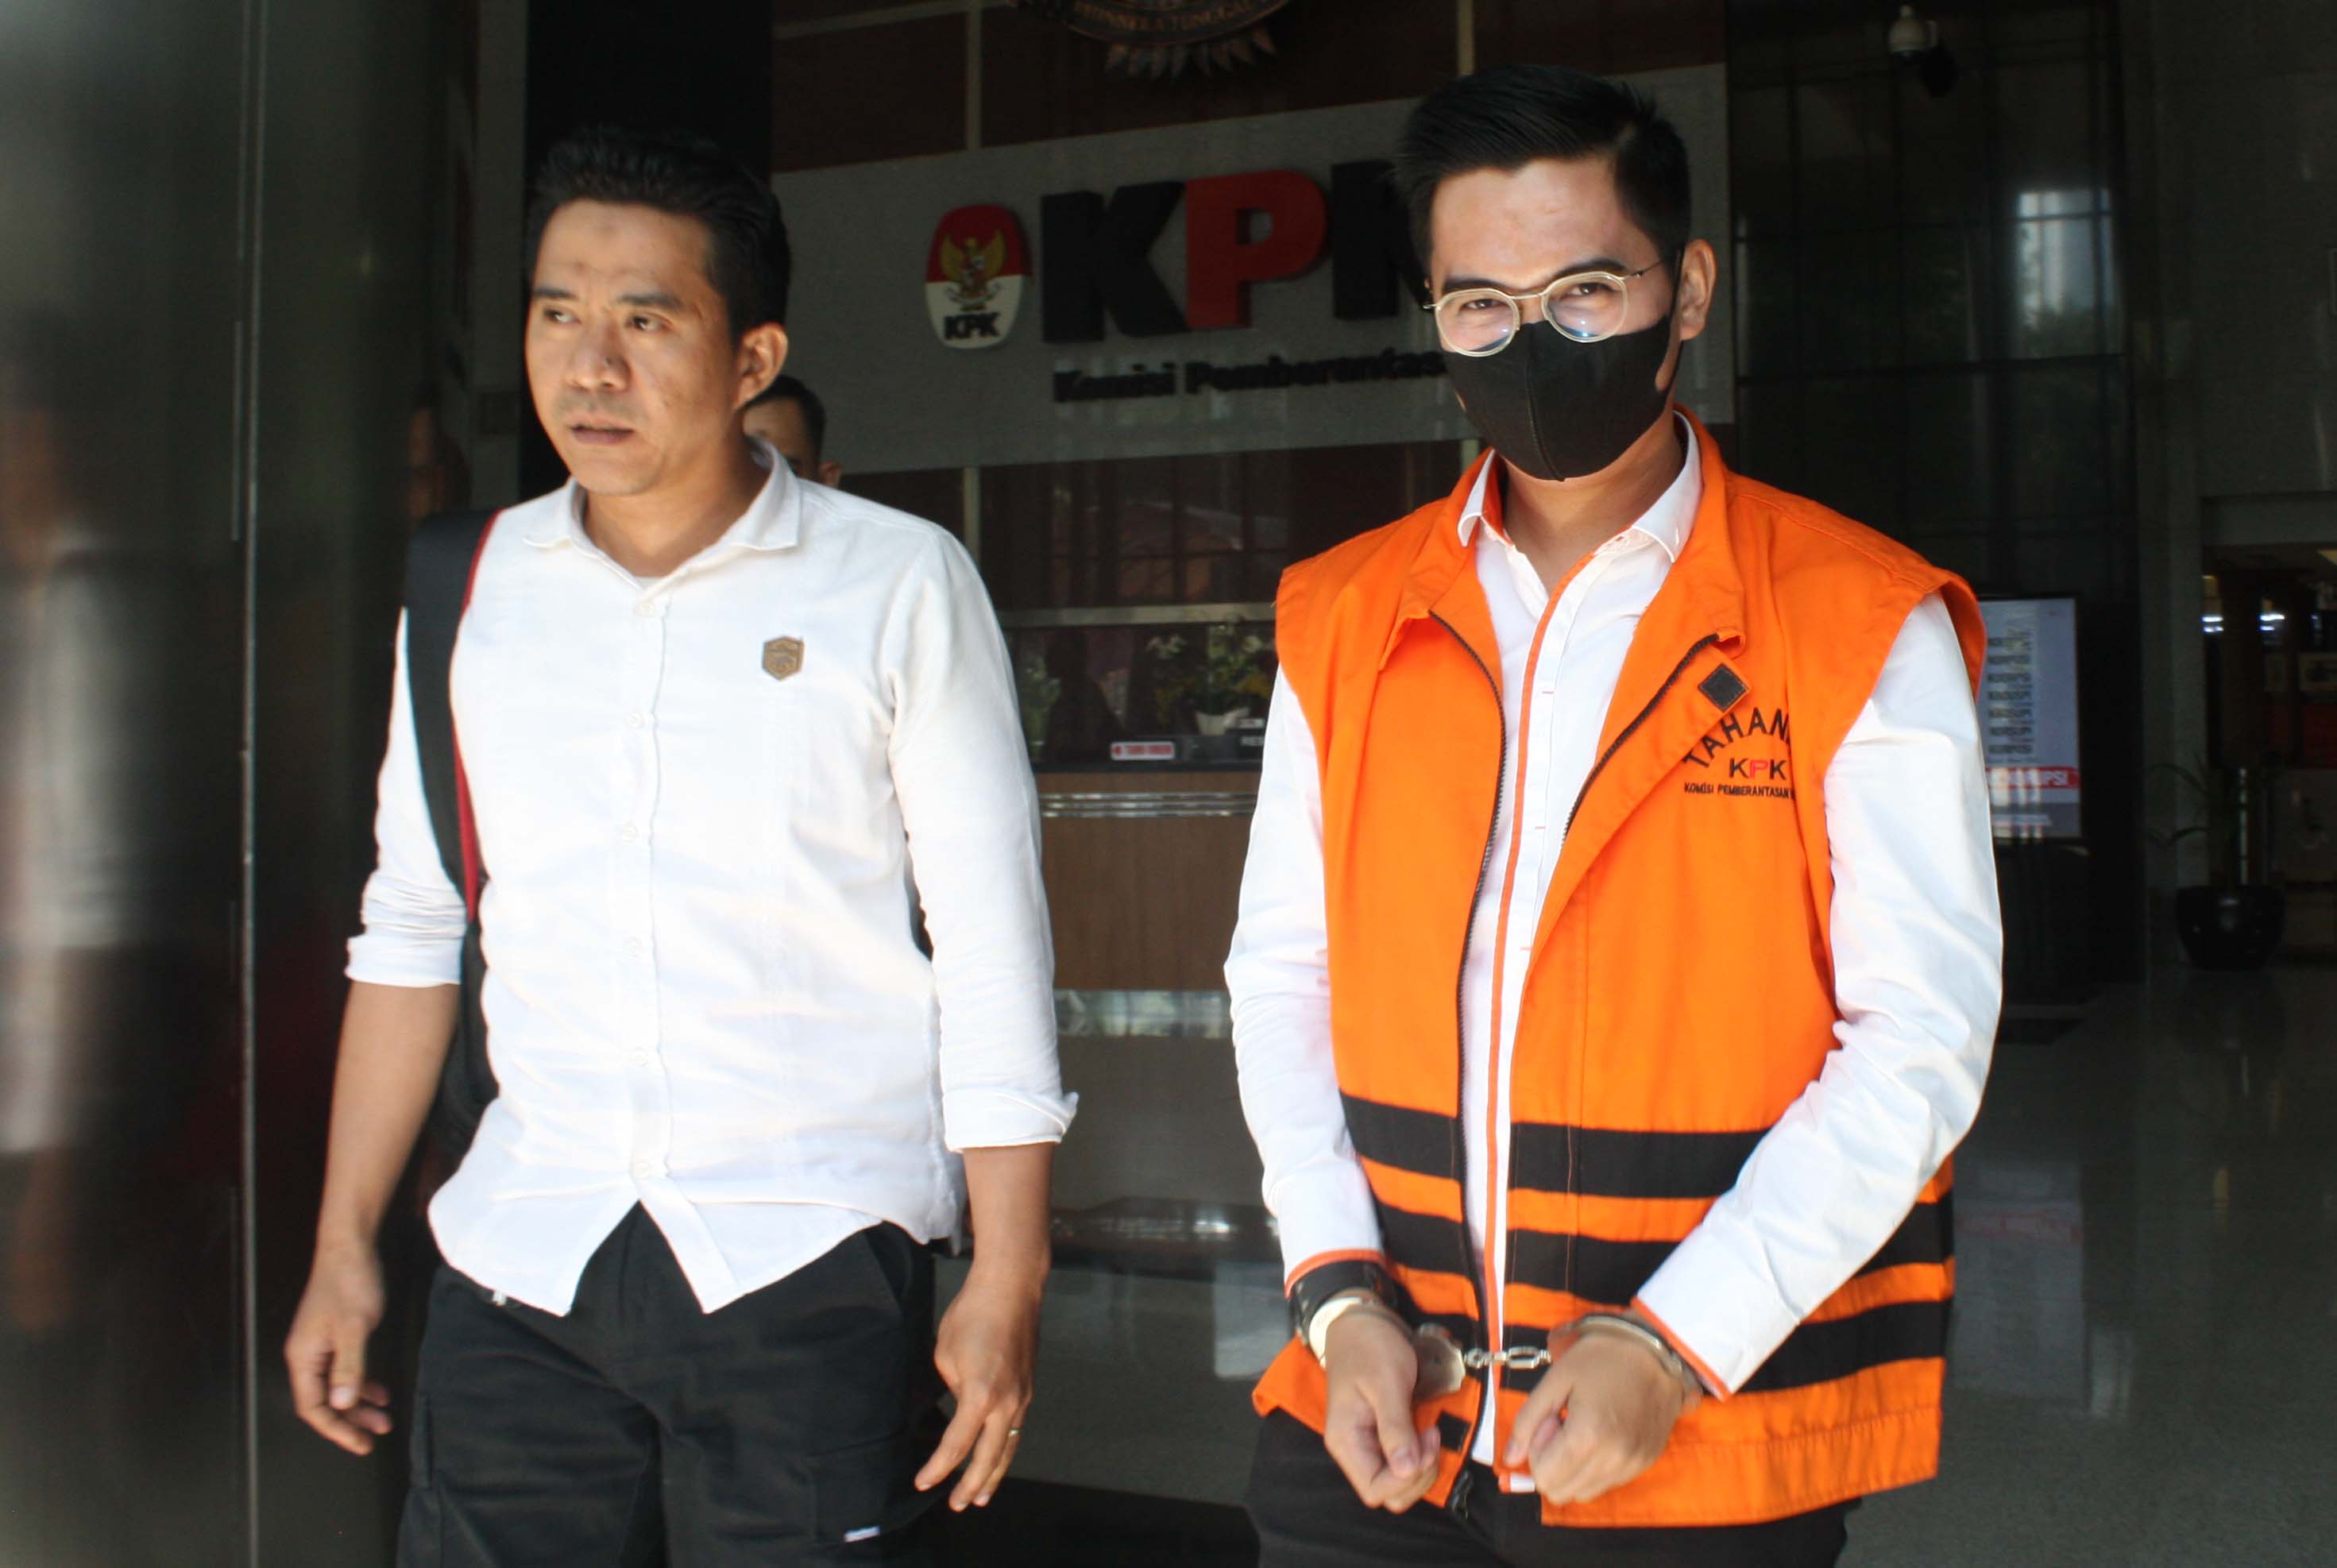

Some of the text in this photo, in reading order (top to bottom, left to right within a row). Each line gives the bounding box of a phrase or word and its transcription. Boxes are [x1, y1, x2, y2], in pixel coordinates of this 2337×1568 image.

[944, 312, 999, 340] KPK
[1729, 757, 1787, 781] KPK
[1684, 782, 1714, 794] KOMISI
[1717, 783, 1789, 799] PEMBERANTASAN
